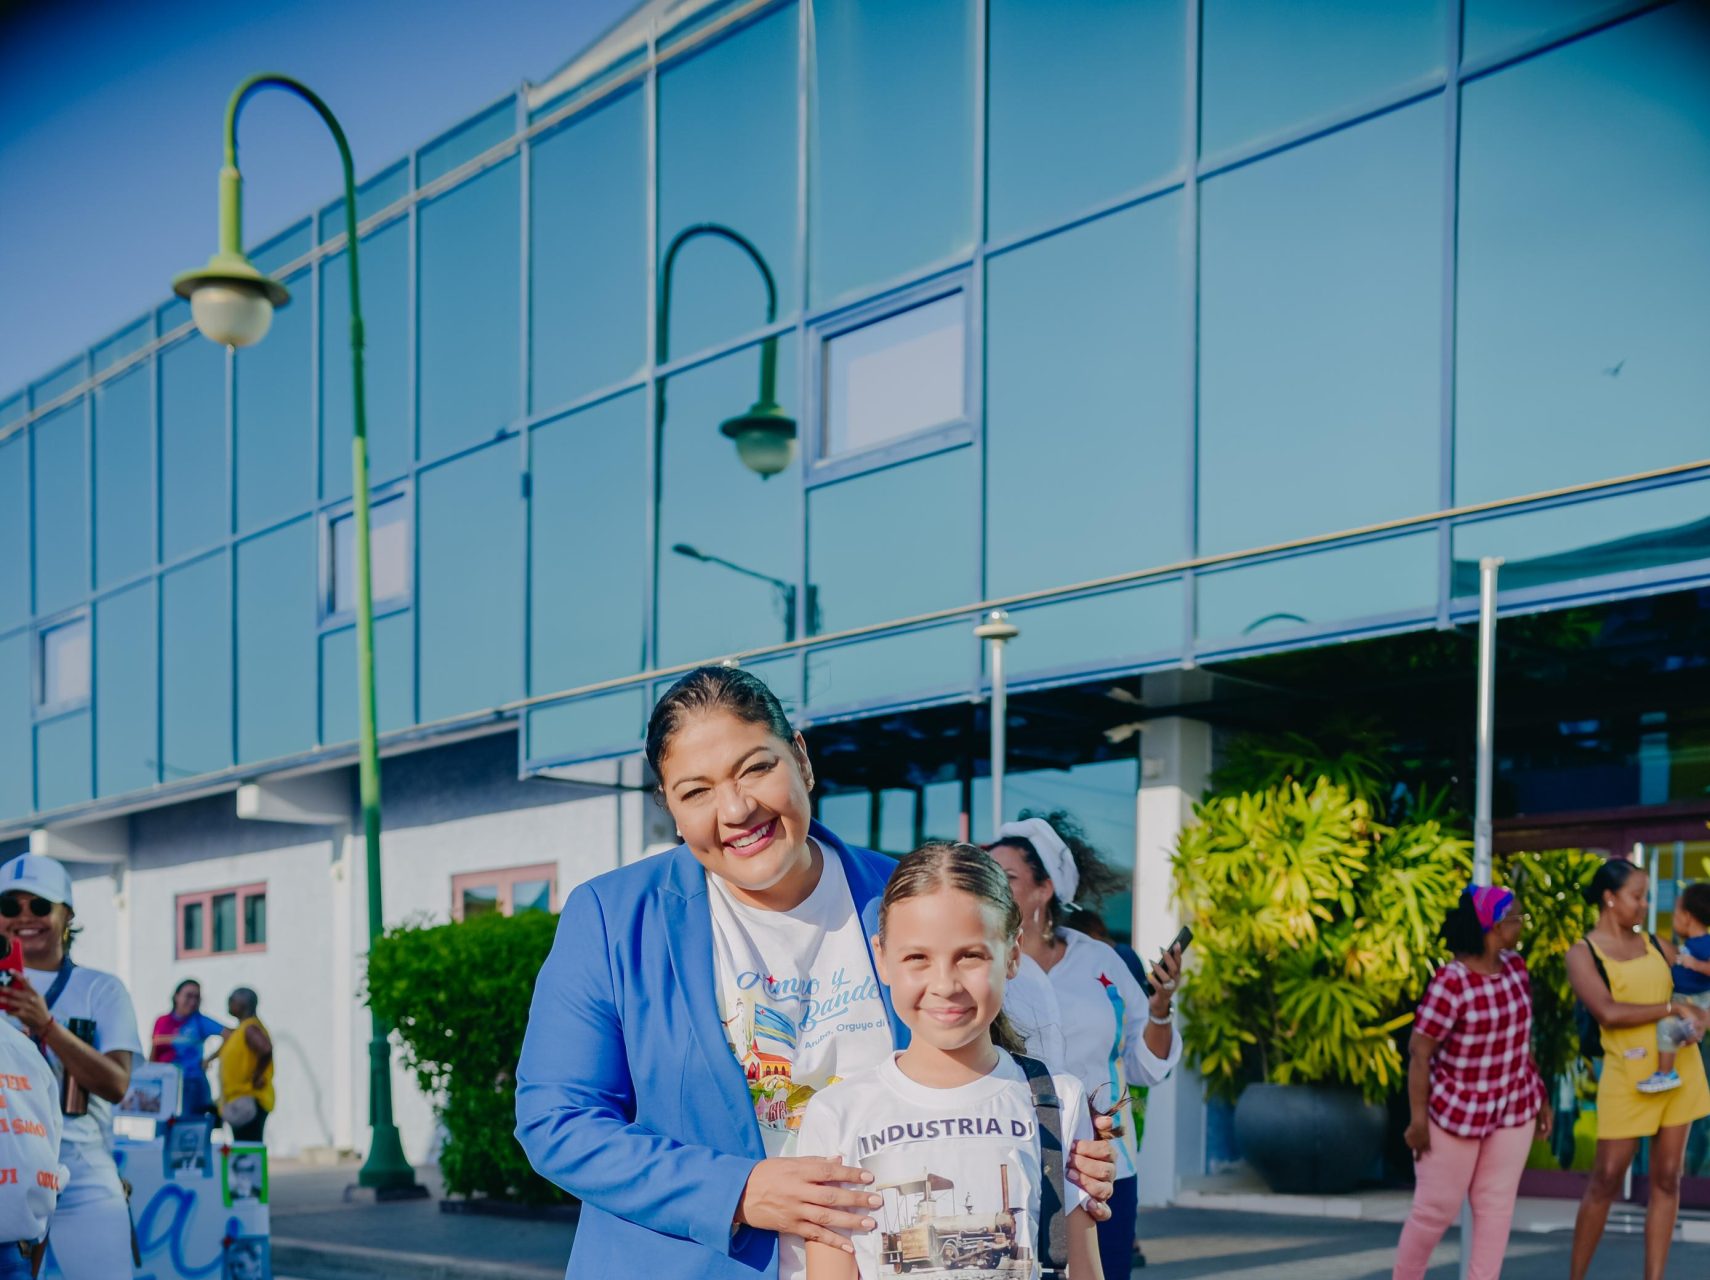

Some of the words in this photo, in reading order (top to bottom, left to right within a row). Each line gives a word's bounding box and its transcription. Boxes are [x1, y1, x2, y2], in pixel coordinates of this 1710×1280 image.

[831, 968, 851, 993] y
[836, 1022, 873, 1033] Orguyo
[861, 1118, 1003, 1154] INDUSTRIA
[1011, 1119, 1033, 1137] DI
